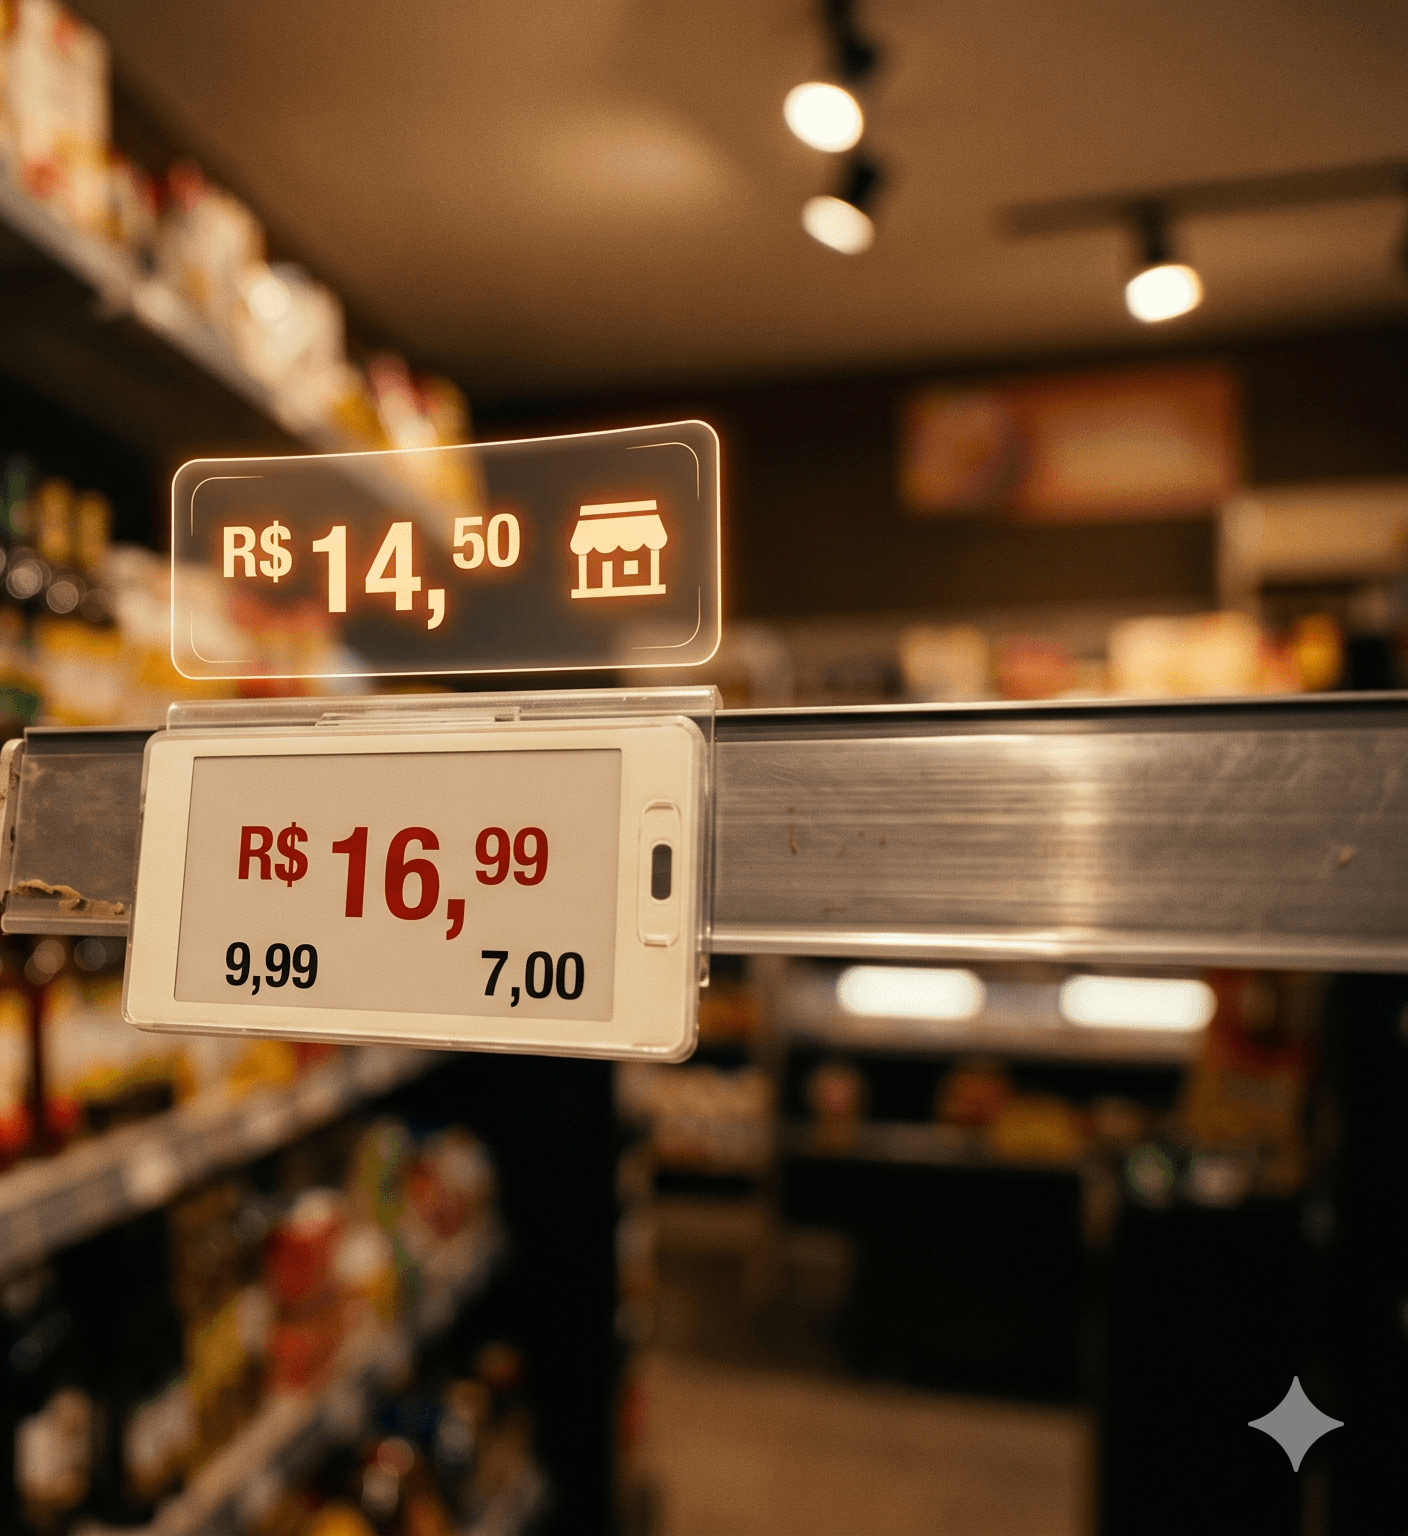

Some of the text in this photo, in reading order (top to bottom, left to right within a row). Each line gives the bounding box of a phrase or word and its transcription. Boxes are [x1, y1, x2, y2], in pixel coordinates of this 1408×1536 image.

[224, 513, 520, 630] R$ 14,50
[239, 821, 549, 941] R$ 16,99
[225, 941, 318, 996] 9,99
[481, 949, 585, 1008] 7,00
